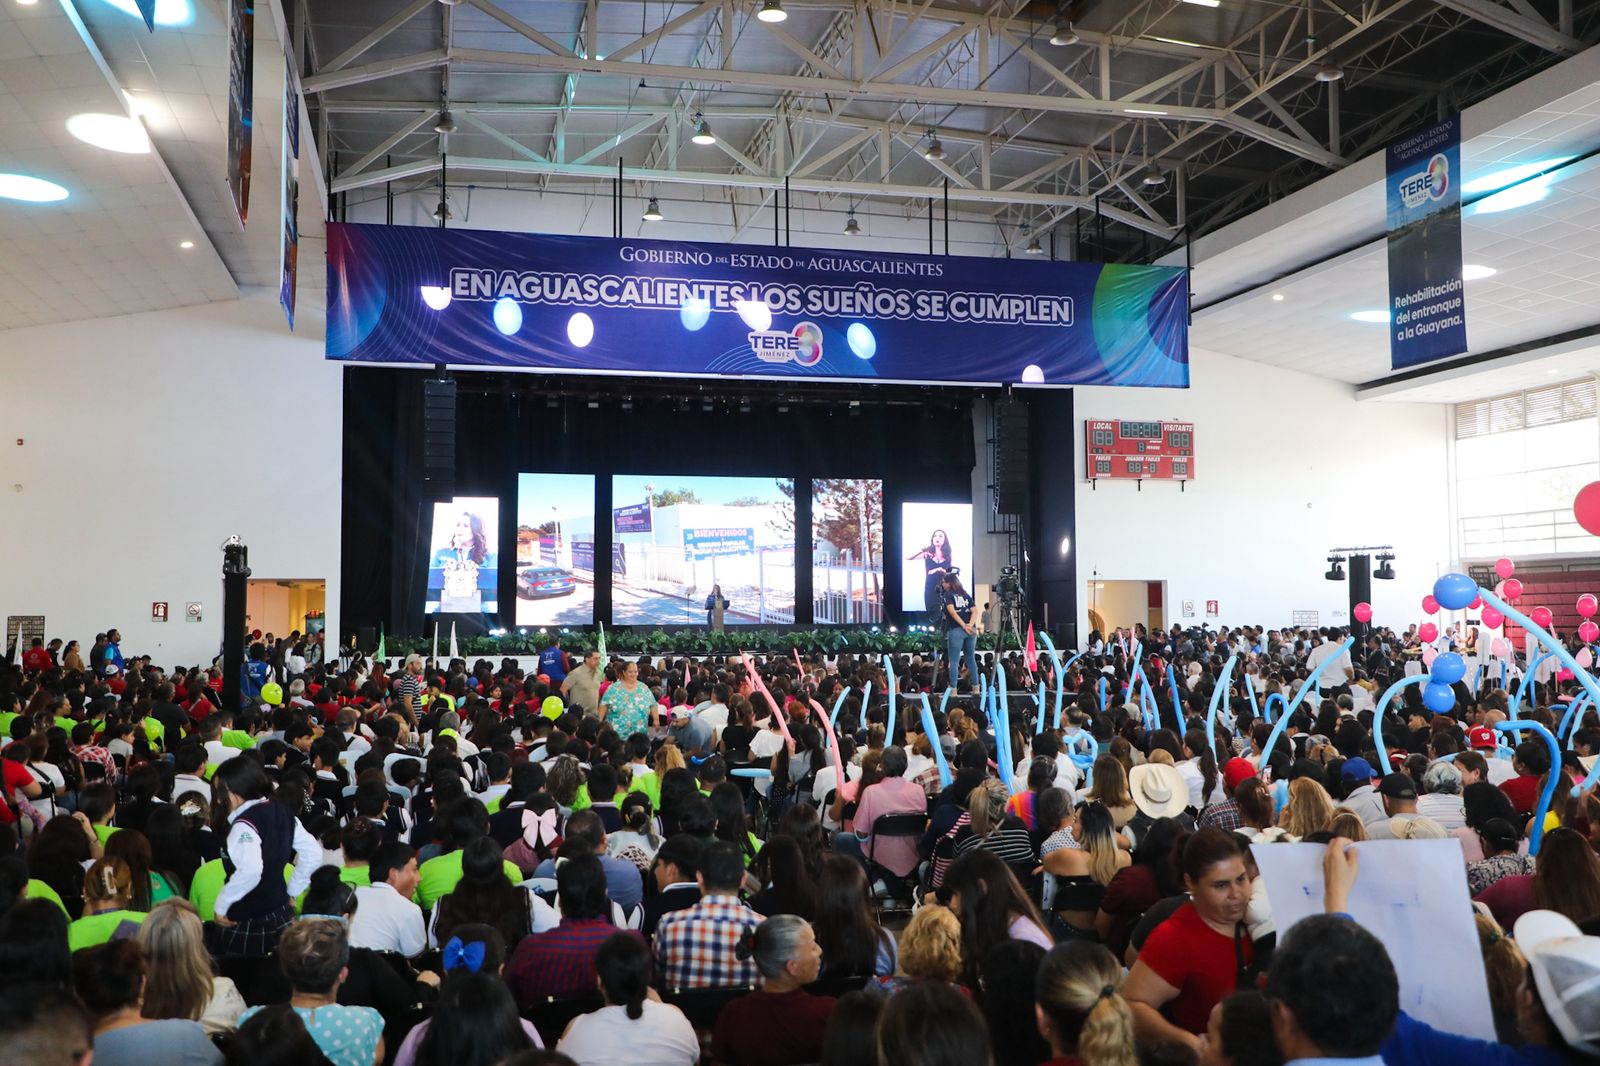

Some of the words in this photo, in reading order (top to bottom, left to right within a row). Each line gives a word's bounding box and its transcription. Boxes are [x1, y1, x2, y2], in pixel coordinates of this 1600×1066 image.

[1401, 174, 1433, 198] TERE
[619, 246, 713, 266] GOBIERNO
[730, 254, 794, 270] ESTADO
[807, 257, 944, 277] AGUASCALIENTES
[454, 272, 492, 297] EN
[498, 274, 746, 309] AGUASCALIENTES
[807, 286, 911, 316] SUEÑOS
[916, 294, 945, 317] SE
[949, 296, 1070, 322] CUMPLEN
[1394, 278, 1462, 309] Rehabilitación
[1396, 310, 1411, 325] del
[1411, 297, 1462, 321] entronque
[1397, 331, 1405, 341] a
[1405, 327, 1414, 339] la
[1415, 314, 1463, 336] Guayana.
[750, 335, 800, 350] TERE
[1093, 422, 1113, 430] LOCAL
[1163, 424, 1193, 432] VISITANTE
